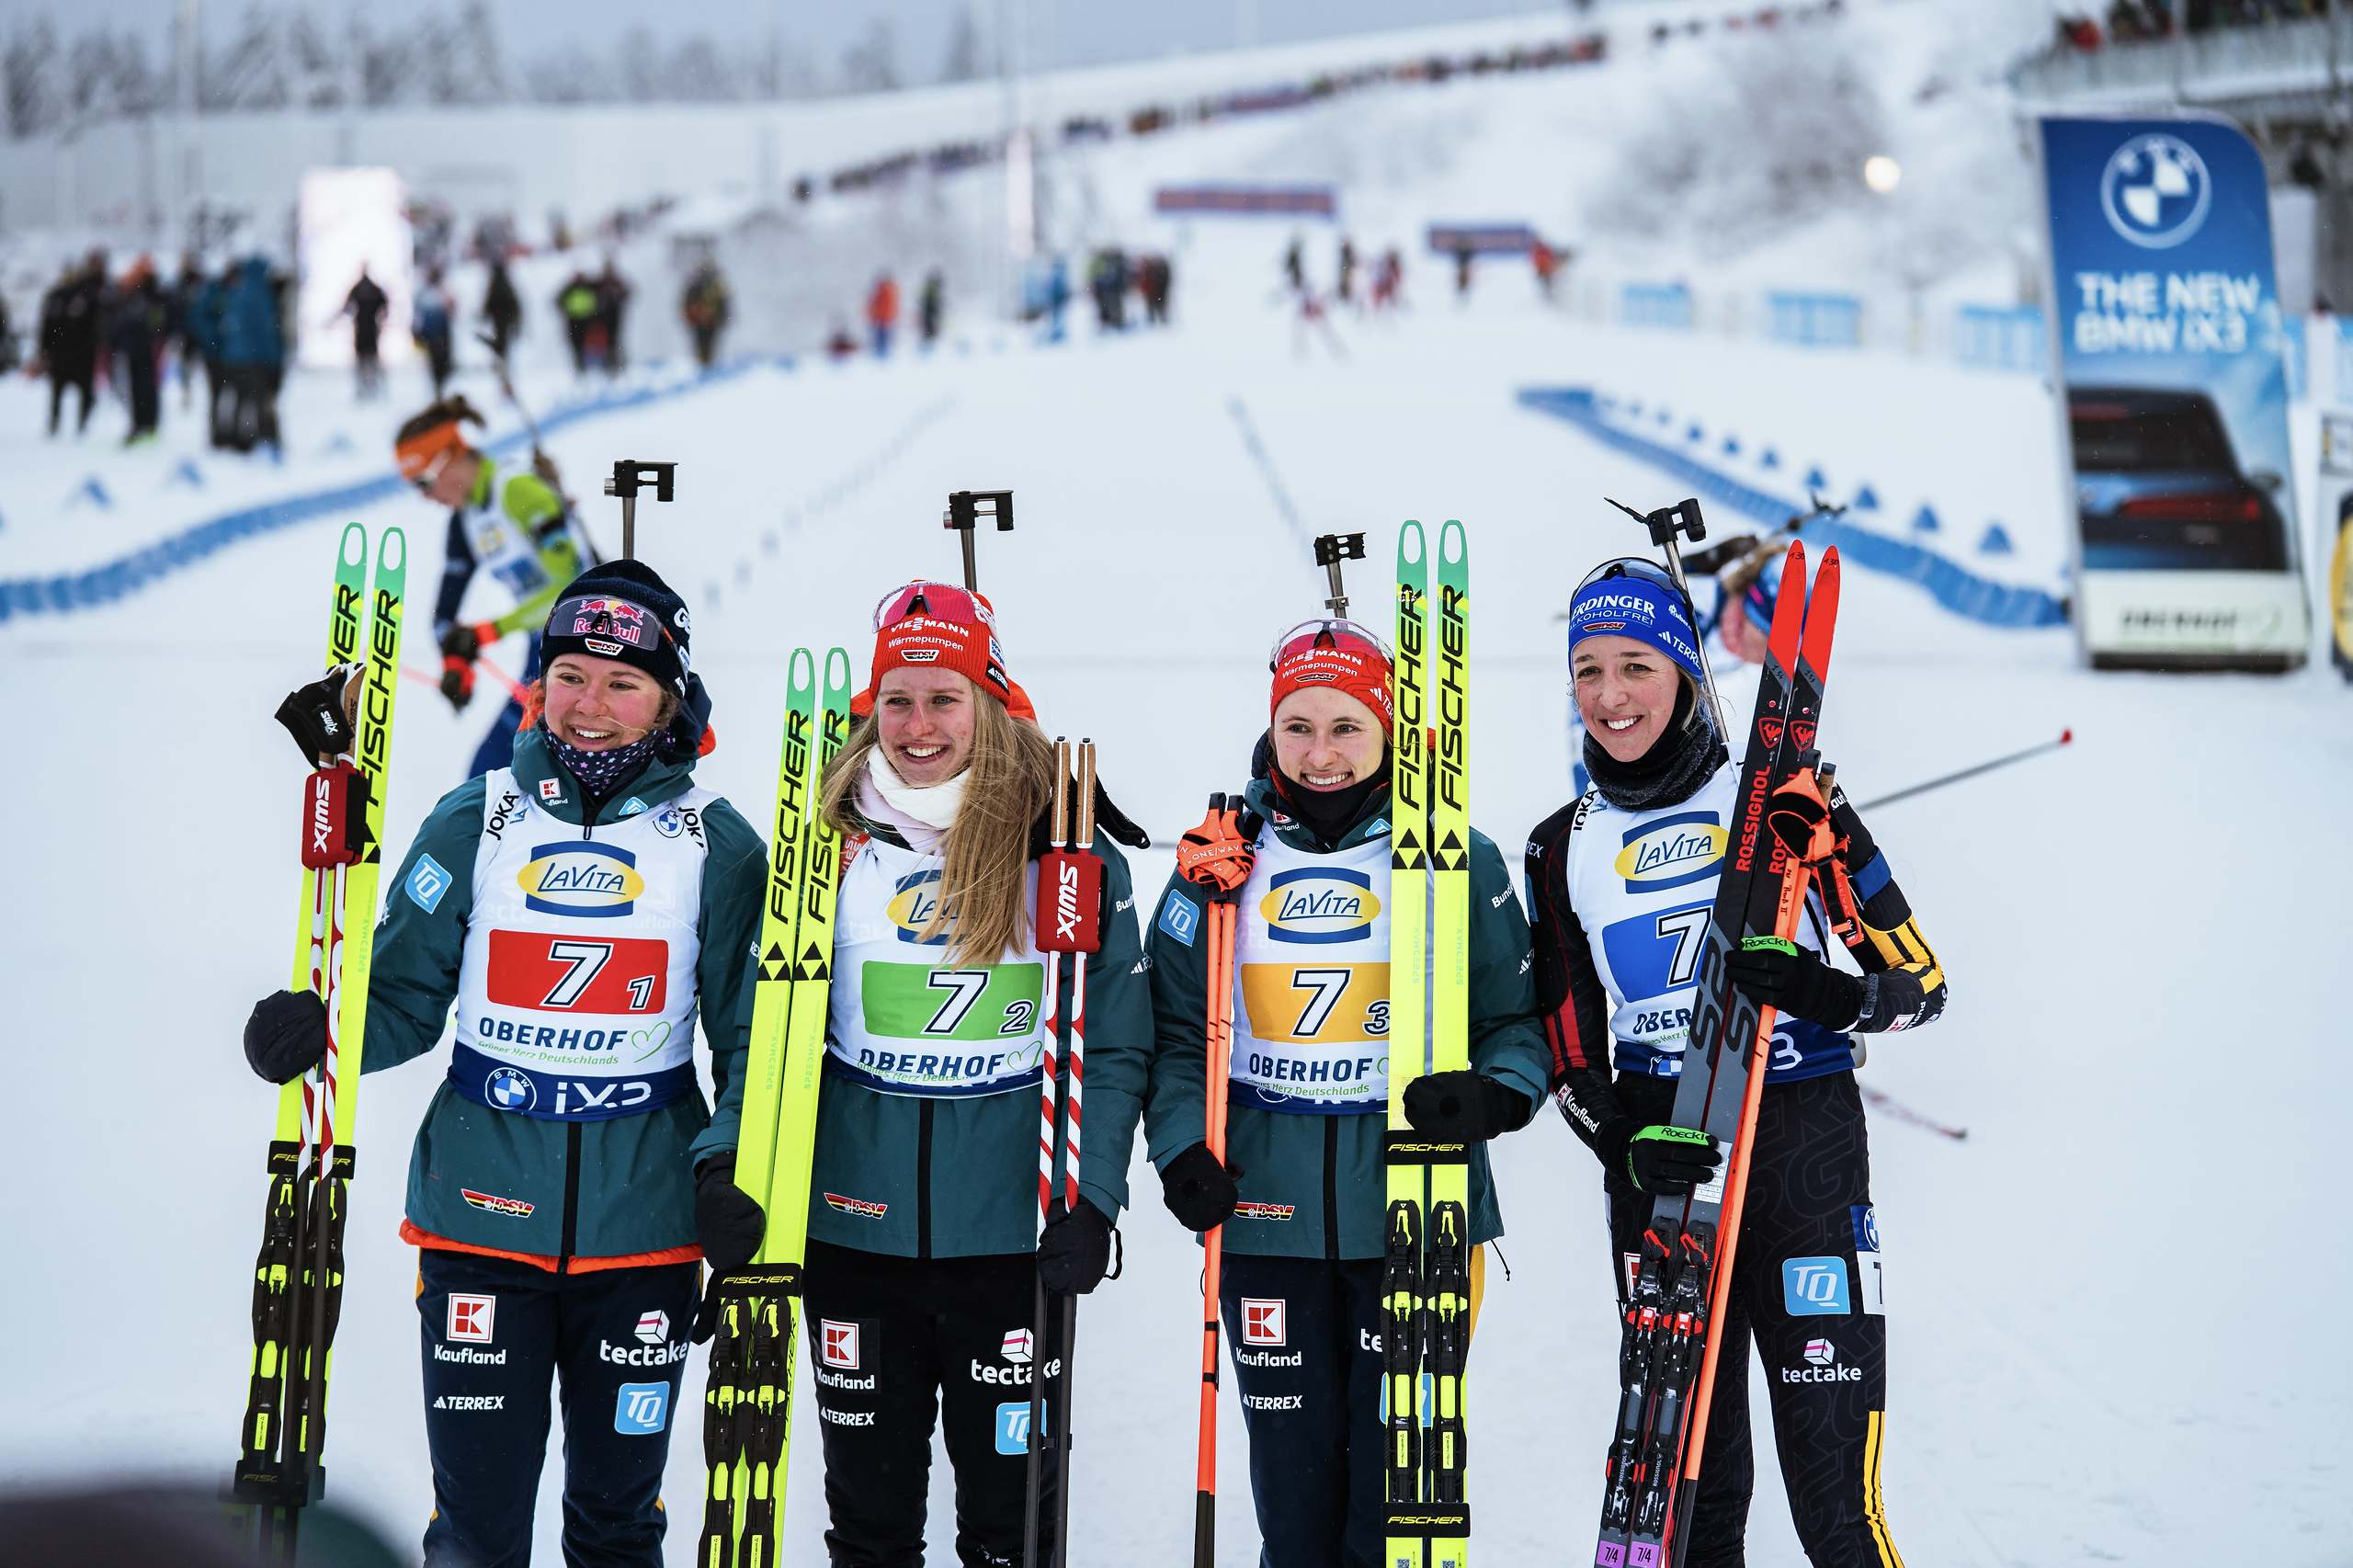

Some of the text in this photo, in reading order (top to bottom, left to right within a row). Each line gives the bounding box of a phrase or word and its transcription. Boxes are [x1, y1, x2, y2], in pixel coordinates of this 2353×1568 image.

[2076, 273, 2260, 313] THE NEW
[574, 617, 642, 644] Red Bull
[1571, 609, 1654, 630] LKOHOLFREI
[888, 635, 964, 653] Wärmepumpen
[1281, 661, 1358, 678] Wärmepumpen
[362, 588, 399, 807] FISCHER
[1399, 584, 1422, 811] FISCHER
[1441, 584, 1463, 812] FISCHER
[485, 790, 519, 840] JOKA
[770, 708, 809, 926] FISCHER
[807, 708, 846, 925] FISCER
[1735, 765, 1771, 872] ROSSIGNOL
[1655, 904, 1713, 988] 7
[539, 939, 655, 1010] 7 1
[920, 969, 1034, 1036] 7 2
[1289, 967, 1390, 1038] 7 3
[479, 1016, 628, 1051] OBERHOF
[1632, 1007, 1692, 1035] OBER
[539, 1051, 619, 1065] Deutschlands
[859, 1048, 1006, 1077] OBERHOF
[1249, 1051, 1373, 1083] OBERHOF
[494, 1069, 530, 1088] BMW
[1272, 1084, 1293, 1095] Herz
[1295, 1084, 1370, 1096] Deutschlands
[1565, 1094, 1600, 1134] Kaufland
[272, 1153, 351, 1166] FISER
[1387, 1142, 1464, 1153] FISCHER
[722, 1275, 795, 1285] FISCHER
[1791, 1265, 1839, 1307] TQ
[434, 1345, 506, 1366] Kaufland
[599, 1339, 688, 1367] tectake
[1235, 1347, 1302, 1368] Kaufland
[815, 1366, 875, 1390] Kaufland
[1782, 1363, 1862, 1383] tectake
[447, 1395, 505, 1411] TERREX
[628, 1391, 662, 1427] TQ
[1249, 1394, 1303, 1410] TERREX
[827, 1411, 875, 1426] TERREX
[242, 1472, 278, 1483] FISC
[1387, 1516, 1464, 1525] FISCHER
[1604, 1546, 1619, 1563] 7/4
[1637, 1547, 1653, 1563] 7/4
